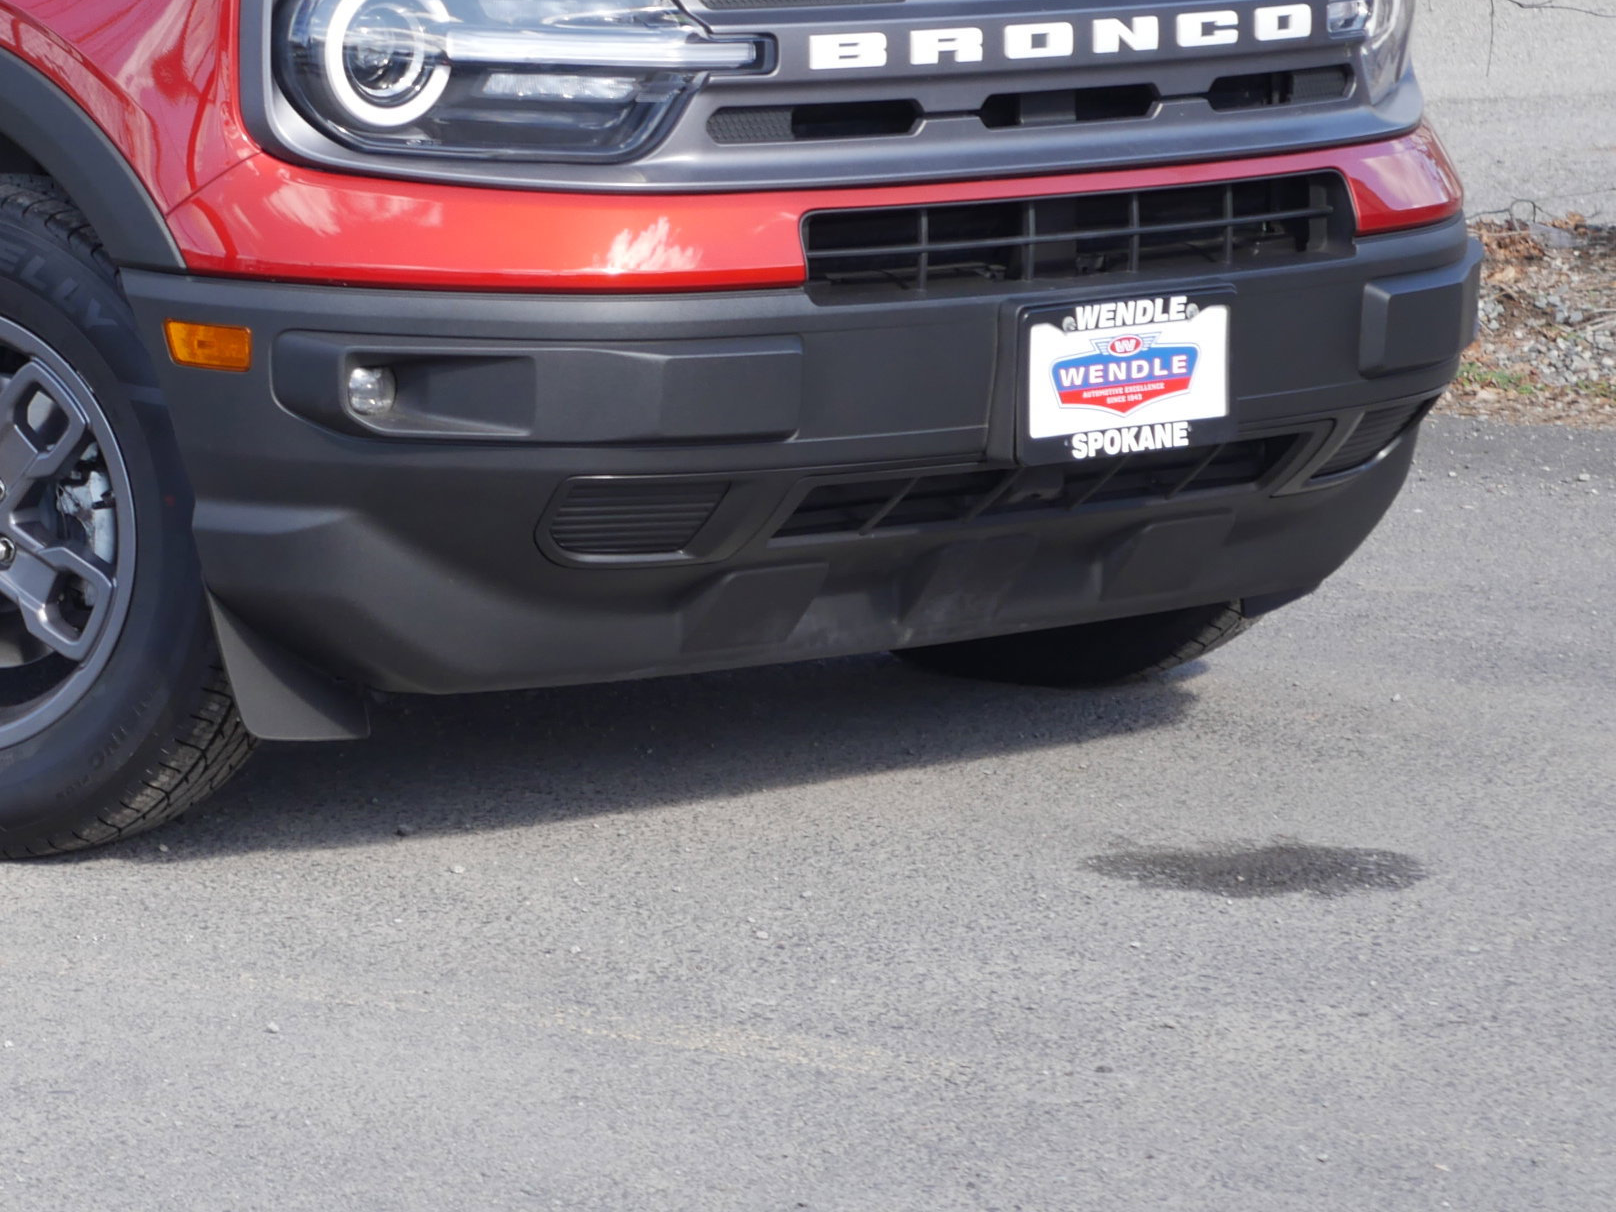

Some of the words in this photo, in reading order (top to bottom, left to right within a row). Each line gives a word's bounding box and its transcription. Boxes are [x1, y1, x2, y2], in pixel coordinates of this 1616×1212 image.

[808, 3, 1312, 70] BRONCO
[1075, 296, 1188, 331] WENDLE
[1060, 354, 1187, 386] WENDLE
[1082, 387, 1124, 398] AUTOMOTIVE
[1072, 421, 1189, 459] SPOKANE
